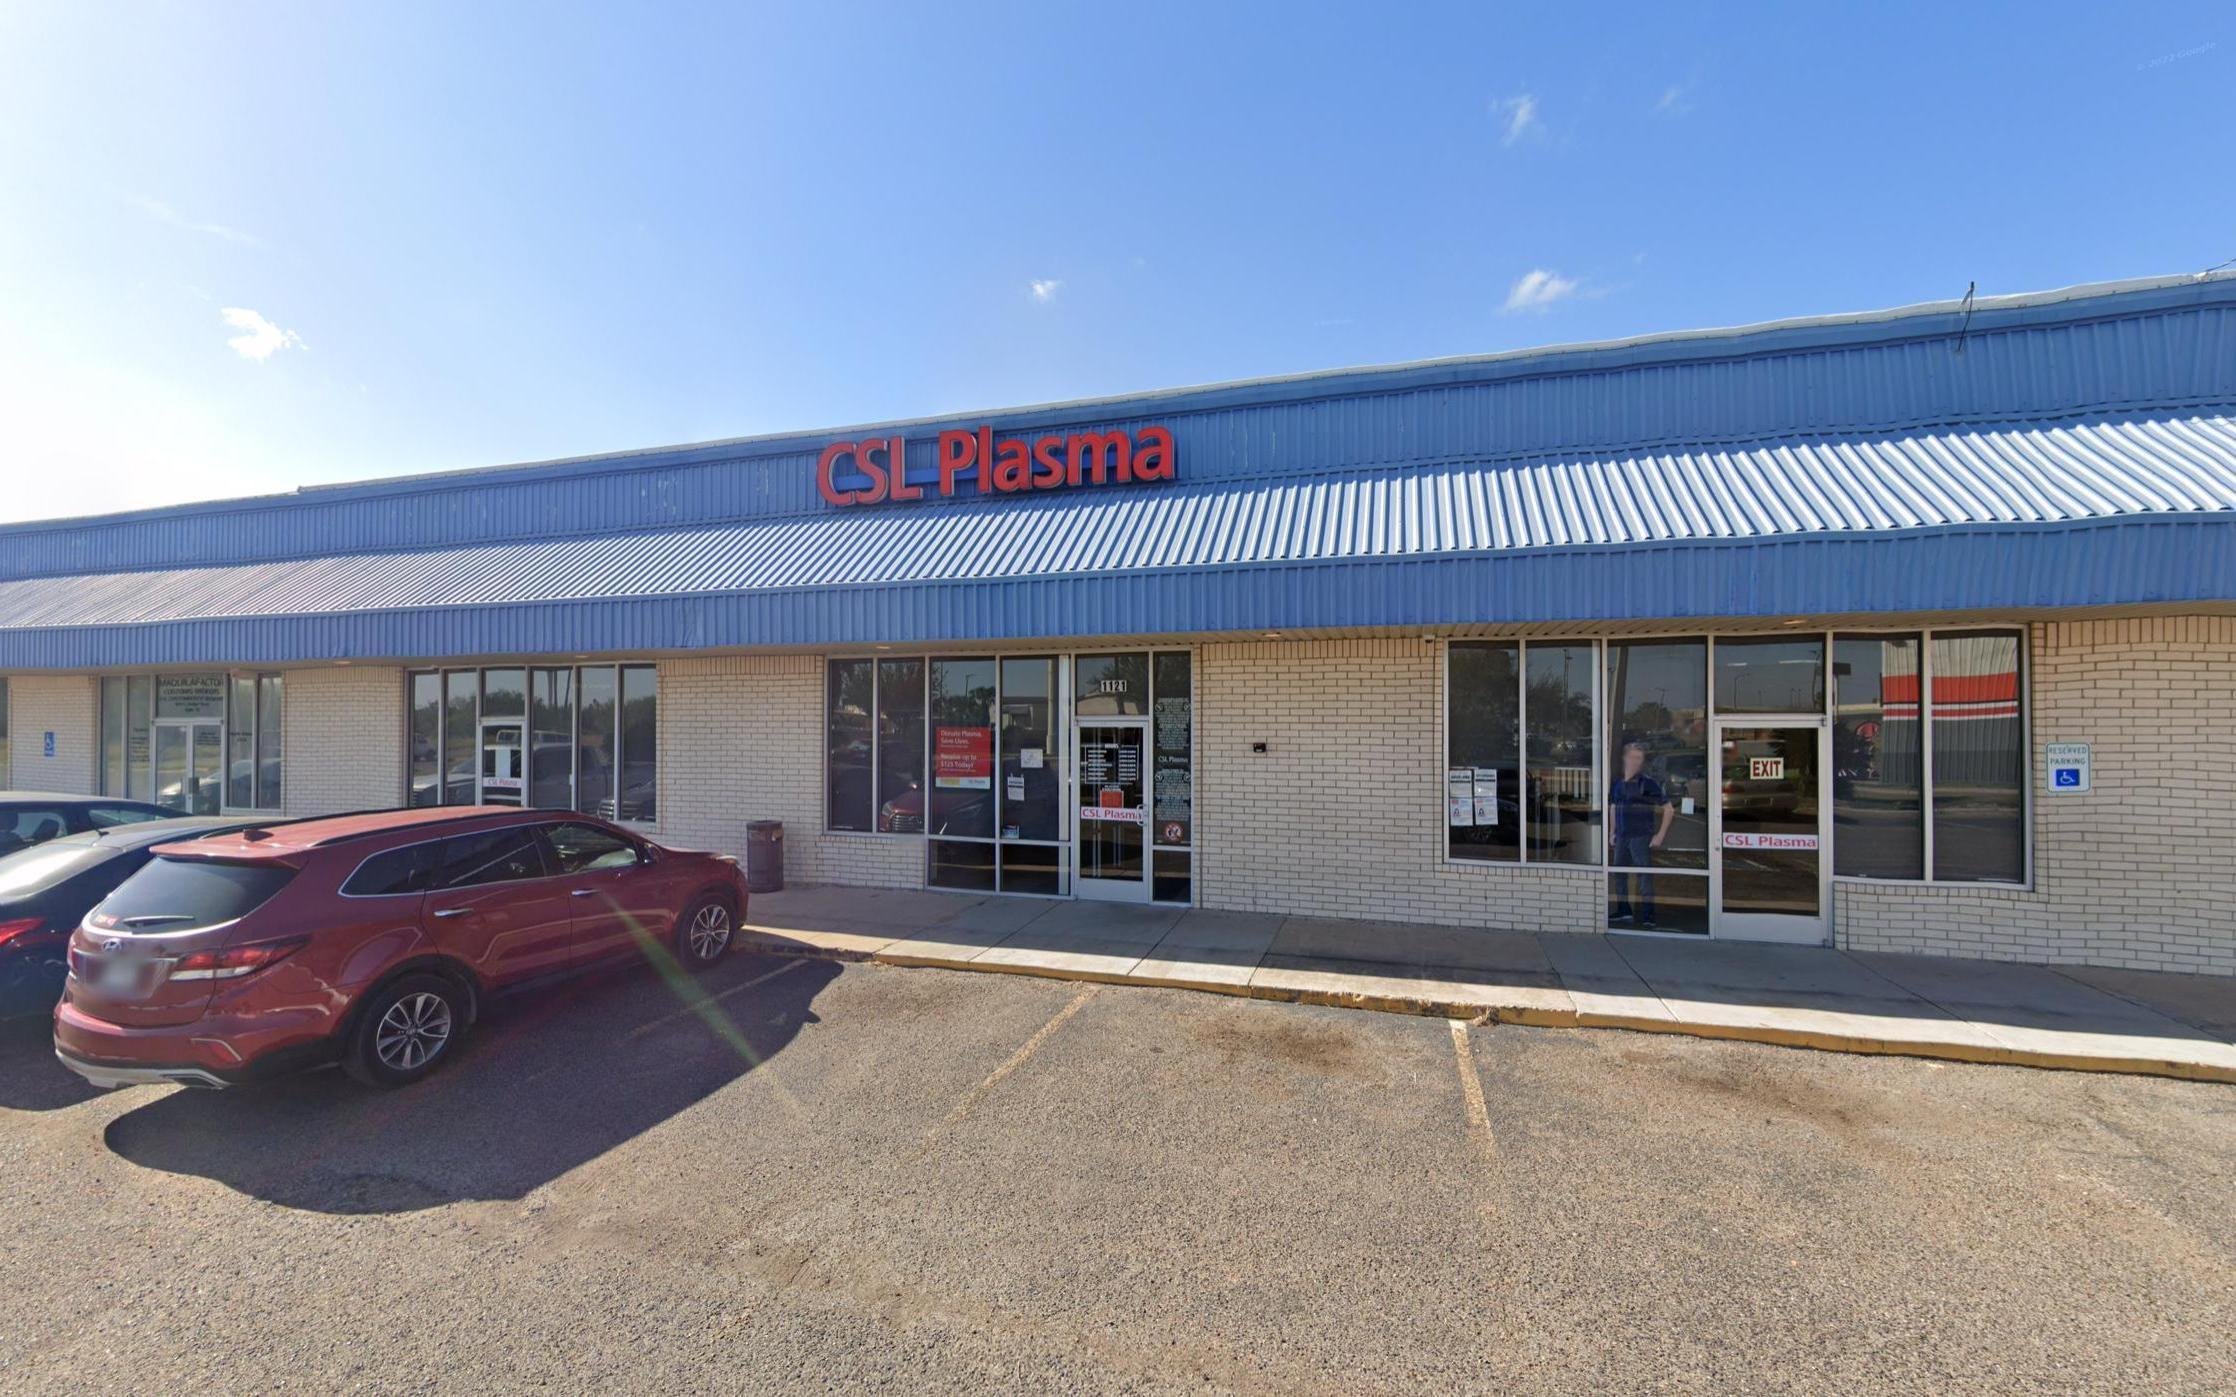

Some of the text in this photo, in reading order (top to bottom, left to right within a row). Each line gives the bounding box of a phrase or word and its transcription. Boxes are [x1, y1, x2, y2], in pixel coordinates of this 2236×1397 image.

[817, 425, 1175, 506] CSL Plasma
[1102, 680, 1126, 692] 1121
[2048, 746, 2087, 754] RESERVED
[1752, 760, 1782, 777] EXIT
[1082, 808, 1102, 818] CSL
[1725, 835, 1817, 848] CSL Plasma
